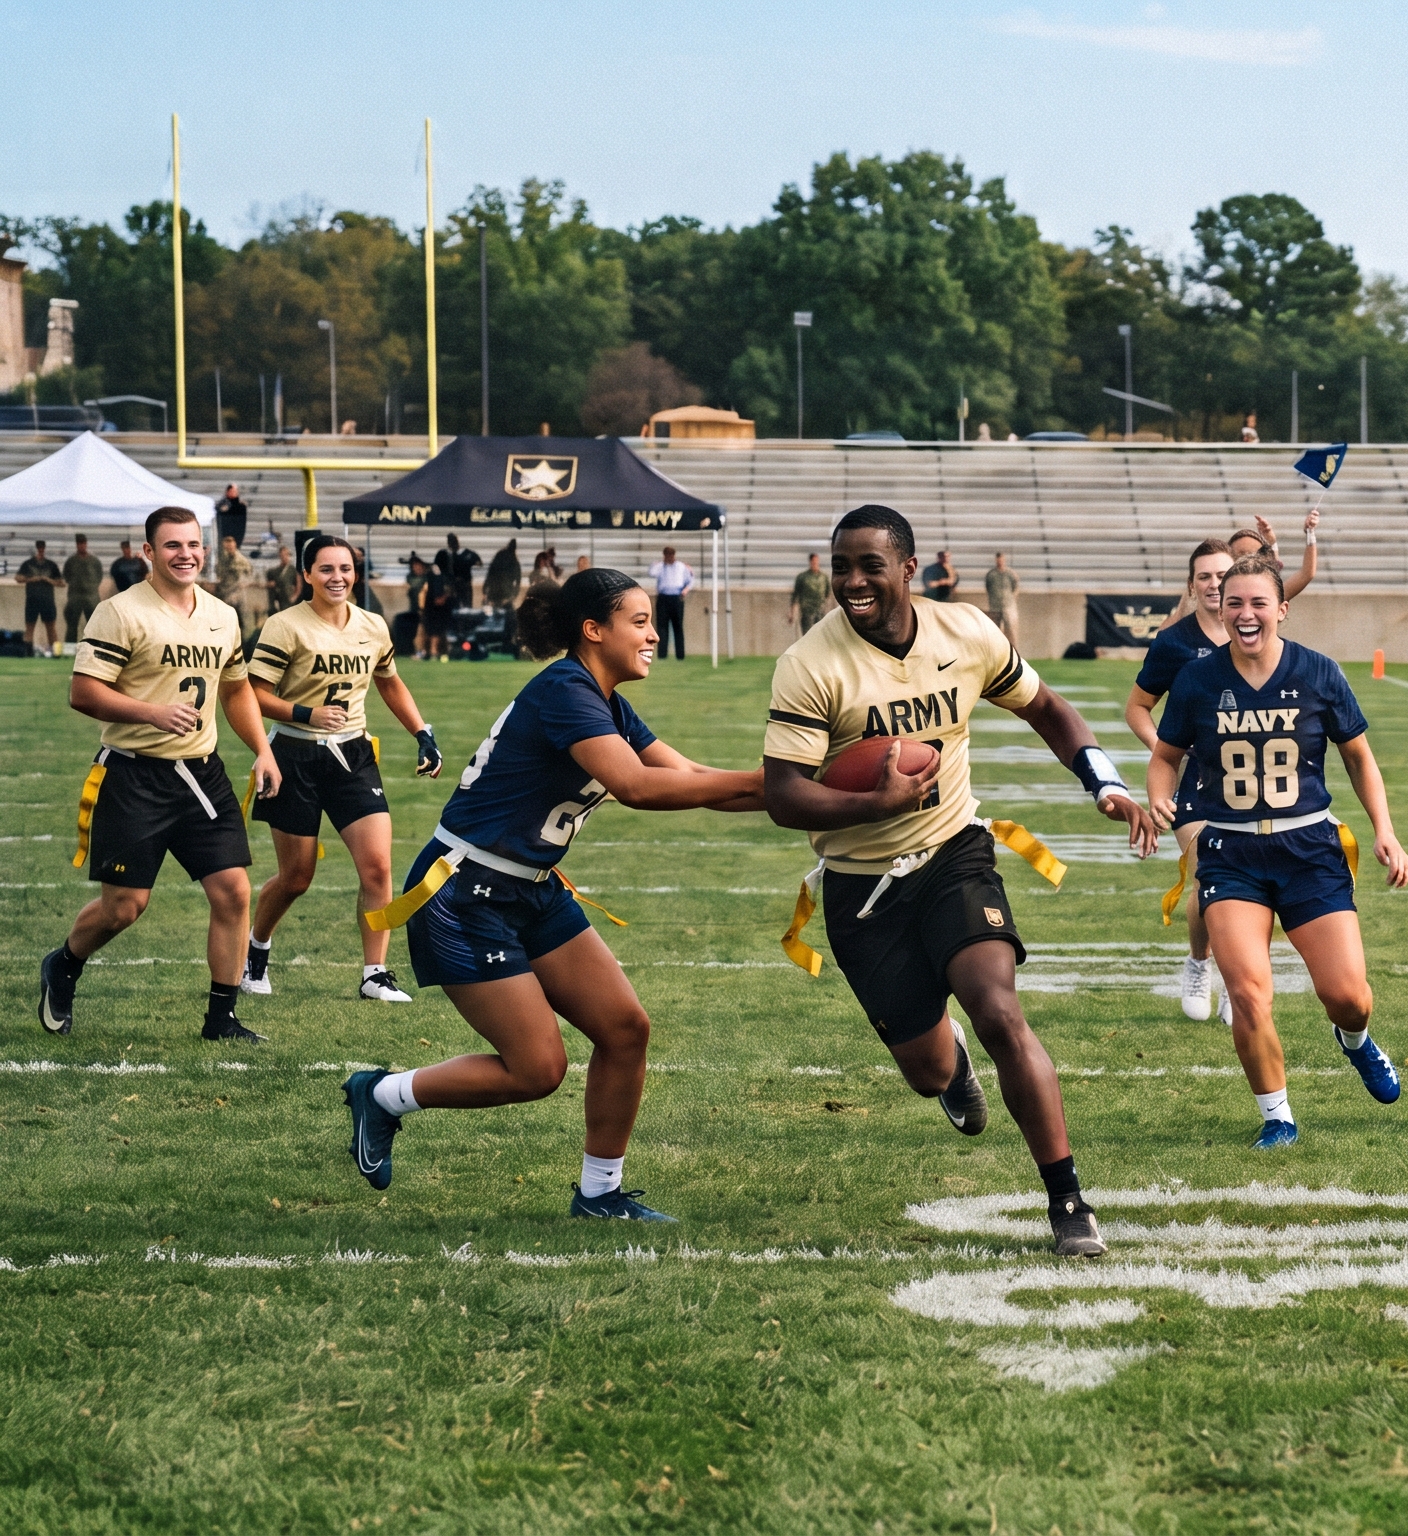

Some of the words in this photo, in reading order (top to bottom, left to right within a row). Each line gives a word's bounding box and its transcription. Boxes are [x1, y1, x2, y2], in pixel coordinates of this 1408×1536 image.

[634, 510, 683, 528] NAVY
[161, 644, 222, 669] ARMY
[311, 654, 370, 675] ARMY
[862, 687, 958, 739] ARMY
[1216, 708, 1300, 734] NAVY
[1220, 738, 1300, 810] 88
